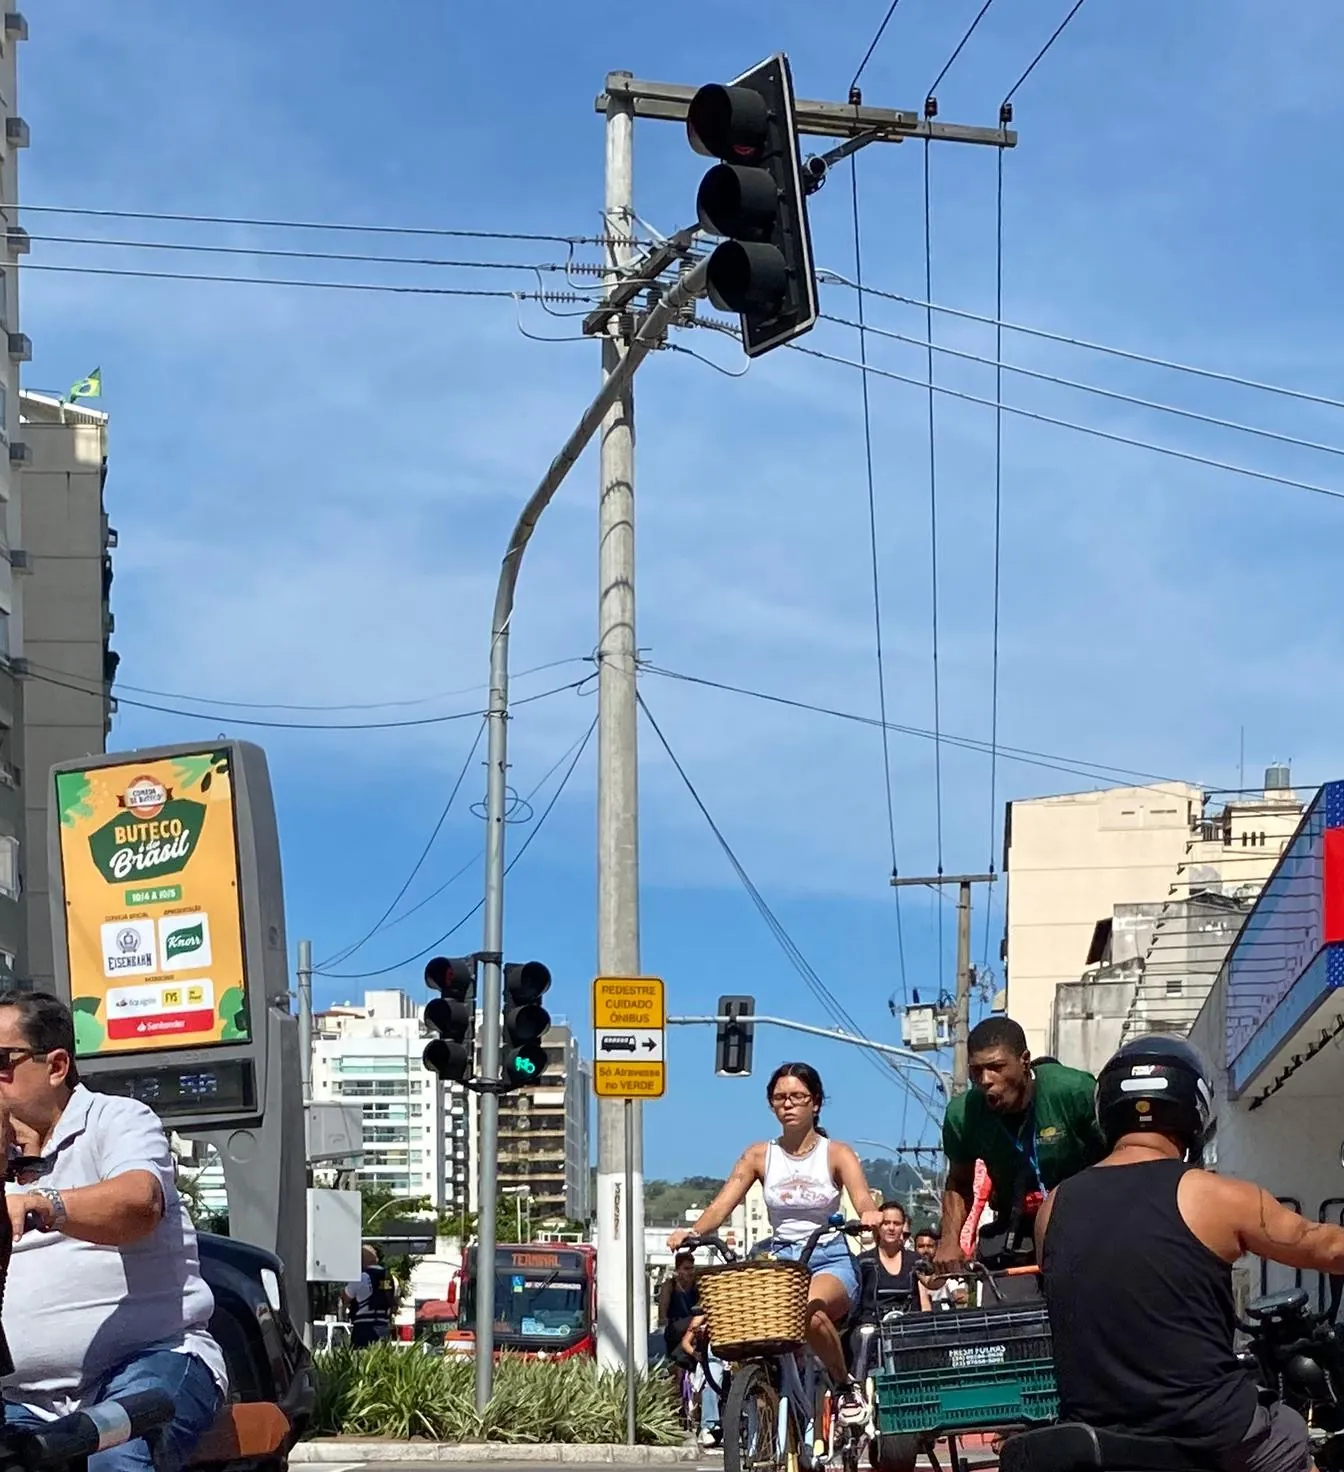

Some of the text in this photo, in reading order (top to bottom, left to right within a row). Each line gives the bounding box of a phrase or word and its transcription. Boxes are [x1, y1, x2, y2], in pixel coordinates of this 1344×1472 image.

[114, 818, 182, 845] BUTECO
[109, 829, 190, 878] Brasil
[167, 935, 200, 949] Knorr
[108, 953, 152, 970] EISENBAHN
[602, 985, 656, 996] PEDESTRE
[605, 999, 653, 1009] CUIDADO
[609, 1011, 650, 1023] ÔNIBUS
[620, 1081, 654, 1090] VERDE
[511, 1252, 562, 1267] TERMINAL
